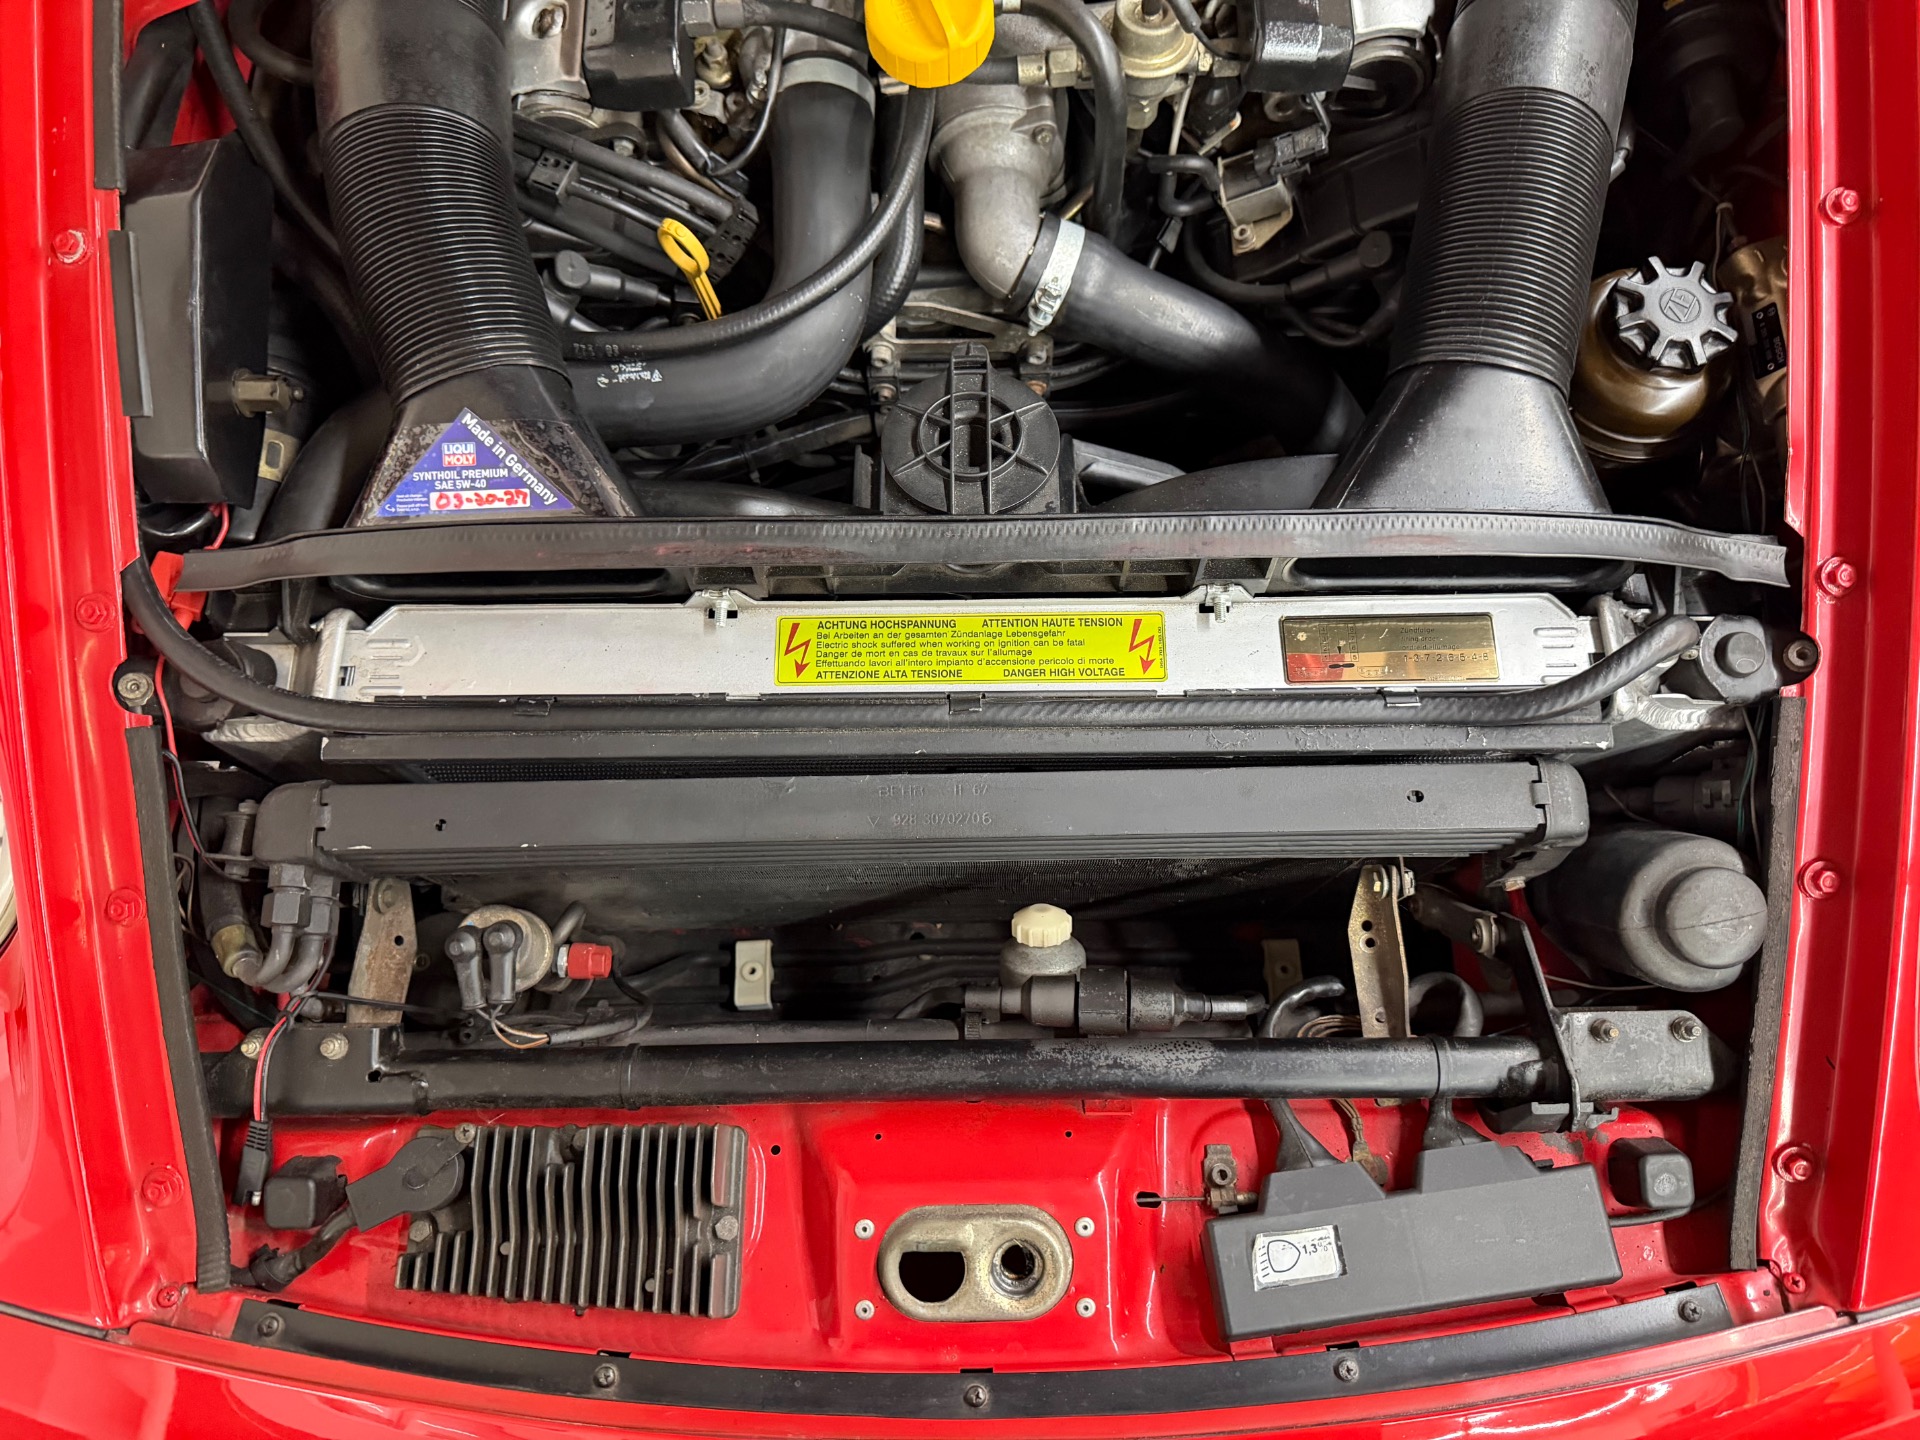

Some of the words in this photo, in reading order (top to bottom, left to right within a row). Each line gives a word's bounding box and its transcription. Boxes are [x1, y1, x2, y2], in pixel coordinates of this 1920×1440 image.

[443, 443, 474, 455] LIQUI
[443, 454, 475, 466] MOLY
[461, 412, 497, 448] Made
[491, 442, 507, 460] in
[505, 454, 559, 506] Germany
[412, 470, 460, 482] SYNTHOIL
[462, 468, 509, 479] PREMIUM
[434, 480, 454, 490] SAE
[456, 479, 487, 490] 5W-40
[817, 620, 867, 630] ACHTUNG
[870, 619, 957, 629] HOCHSPANNUNG
[981, 618, 1038, 628] ATTENTION
[1041, 618, 1075, 627] HAUTE
[1078, 617, 1123, 627] TENSION
[816, 631, 831, 640] Bei
[833, 631, 870, 640] Arbeiten
[887, 631, 901, 639] der
[904, 631, 948, 641] gesamten
[950, 629, 1003, 640] Zündanlage
[1006, 629, 1066, 639] Lebensgefahr
[816, 641, 849, 649] Electric
[851, 640, 878, 649] shock
[880, 640, 916, 648] suffered
[919, 640, 943, 648] when
[946, 639, 981, 649] working
[983, 640, 995, 648] on
[998, 639, 1030, 648] ignition
[1052, 639, 1064, 647] be
[1067, 638, 1085, 646] fatal
[816, 650, 848, 660] Danger
[851, 650, 863, 658] de
[865, 650, 886, 658] mort
[903, 650, 919, 658] cas
[936, 649, 968, 657] travaux
[970, 649, 985, 657] sur
[987, 648, 1033, 658] l'allumage
[815, 658, 866, 668] Effettuando
[868, 659, 893, 667] lavori
[895, 659, 933, 667] all'intero
[936, 658, 974, 668] impianto
[977, 657, 1036, 666] d'accensione
[1038, 656, 1074, 666] pericolo
[1077, 656, 1086, 665] di
[1088, 657, 1115, 665] morte
[816, 670, 880, 680] ATTENZIONE
[883, 669, 908, 679] ALTA
[910, 669, 963, 679] TENSIONE
[1003, 668, 1046, 678] DANGER
[1049, 668, 1075, 677] HIGH
[1078, 667, 1125, 677] VOLTAGE
[893, 812, 917, 826] 928
